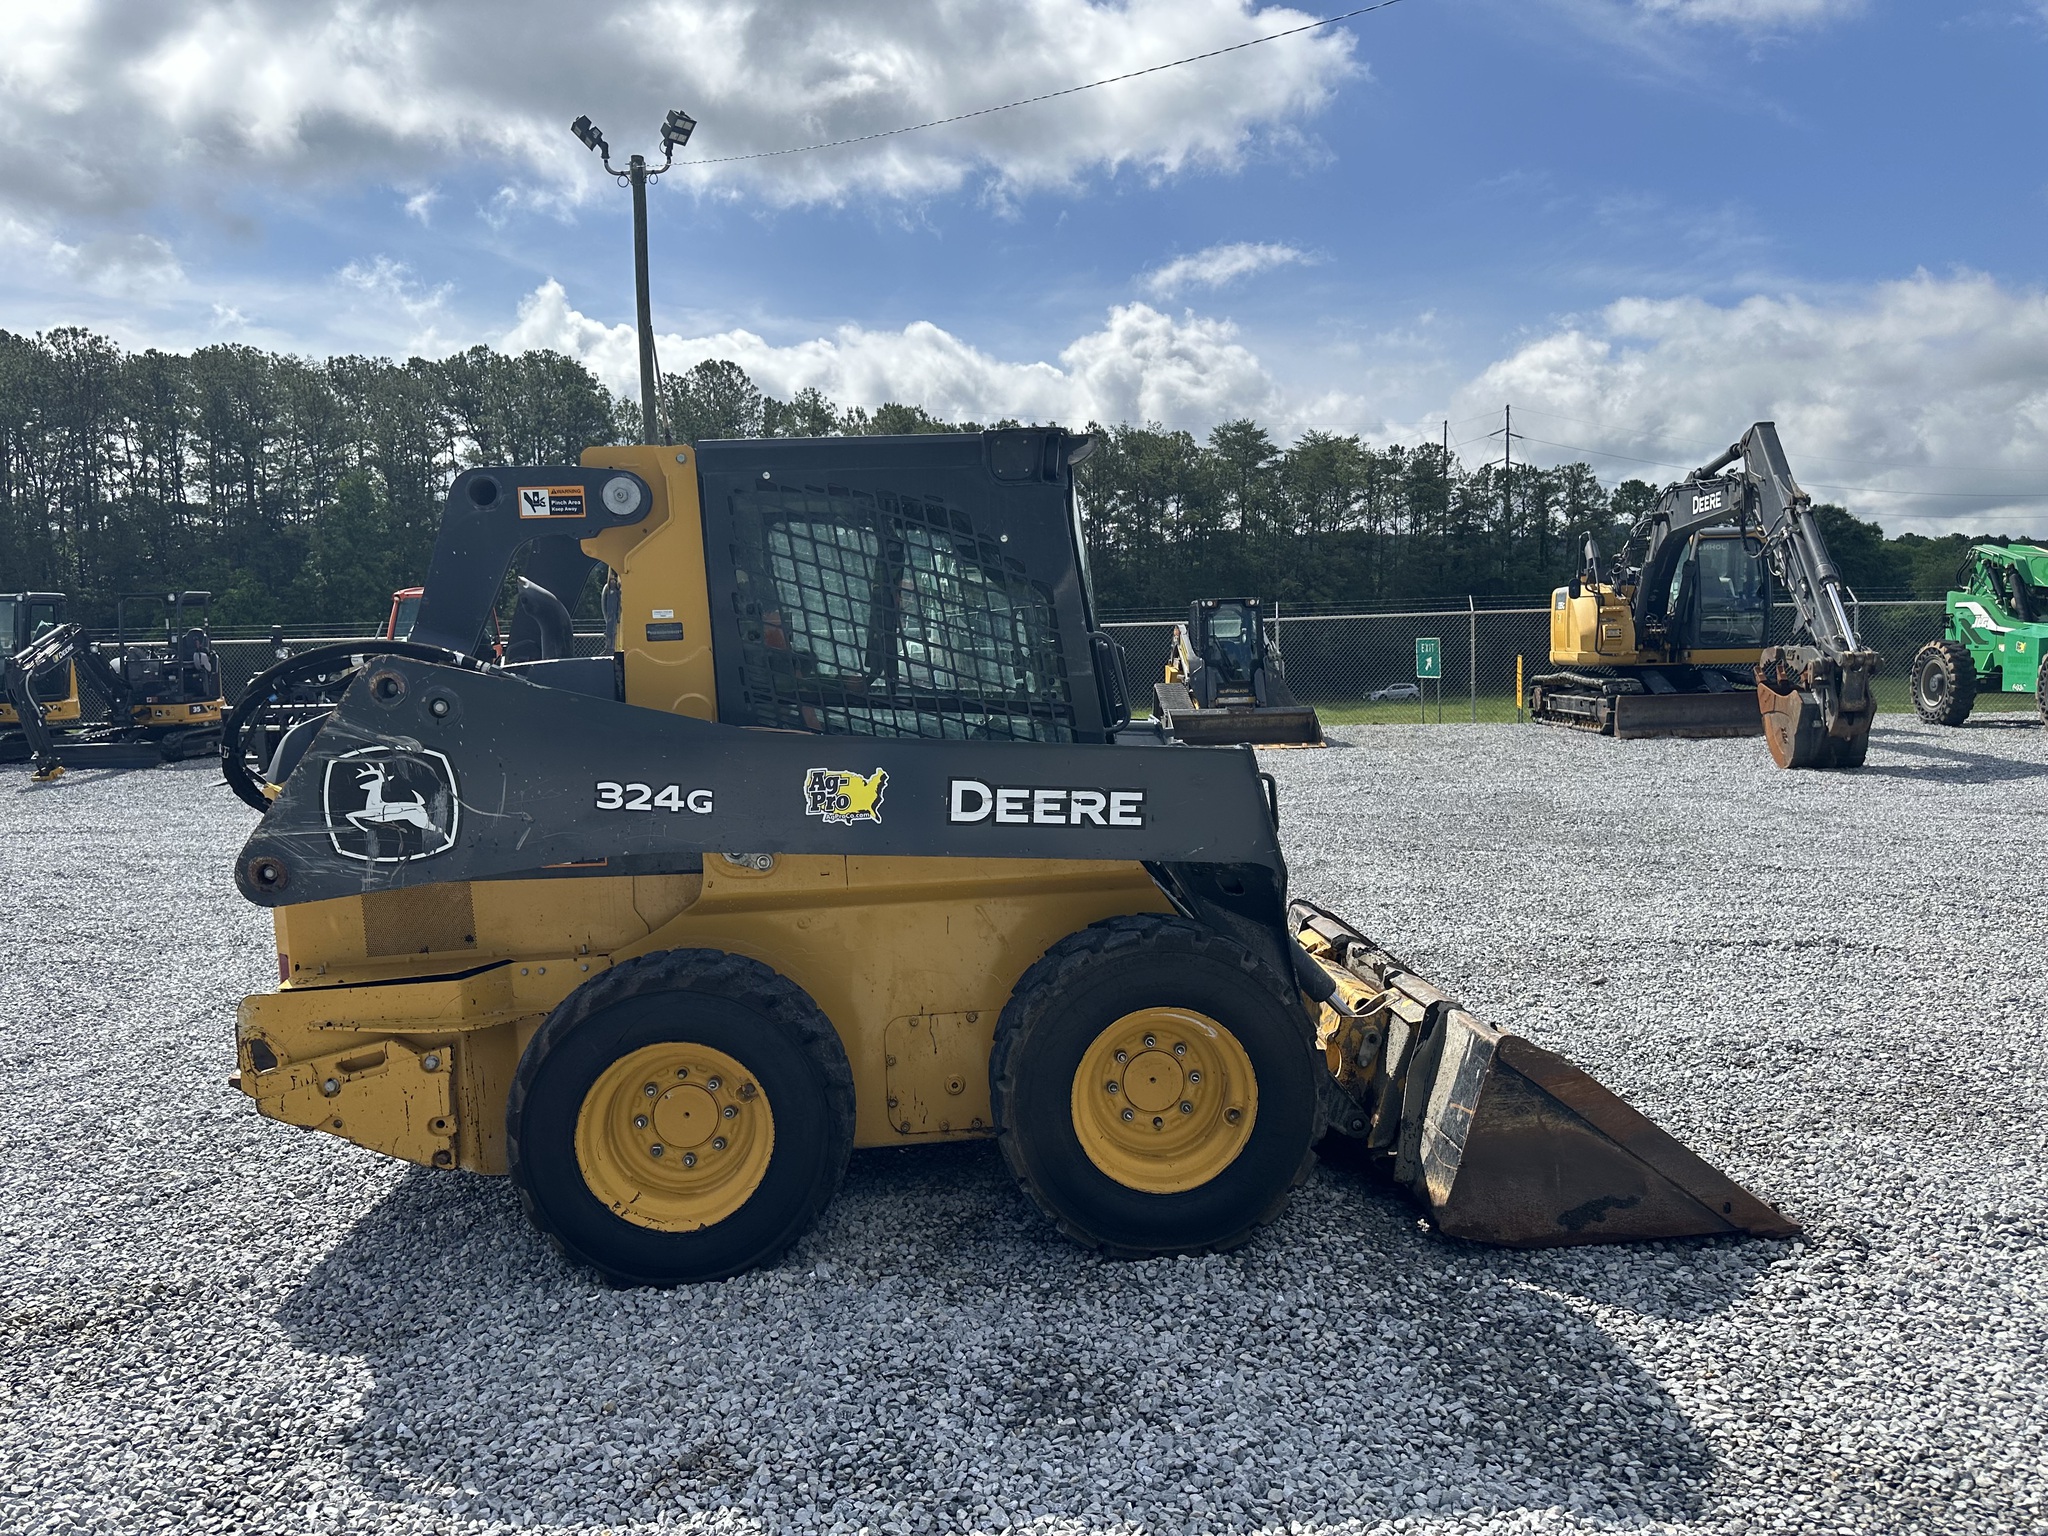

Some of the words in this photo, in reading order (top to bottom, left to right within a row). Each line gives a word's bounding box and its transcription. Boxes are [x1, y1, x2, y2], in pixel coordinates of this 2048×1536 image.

[1692, 491, 1722, 515] DEERE
[58, 643, 74, 659] DEERE
[1421, 643, 1435, 653] EXIT
[809, 771, 849, 795] Ag-
[596, 781, 713, 814] 324G
[810, 791, 850, 812] Pro
[950, 780, 1143, 826] DEERE
[825, 812, 870, 820] AgProCo.com
